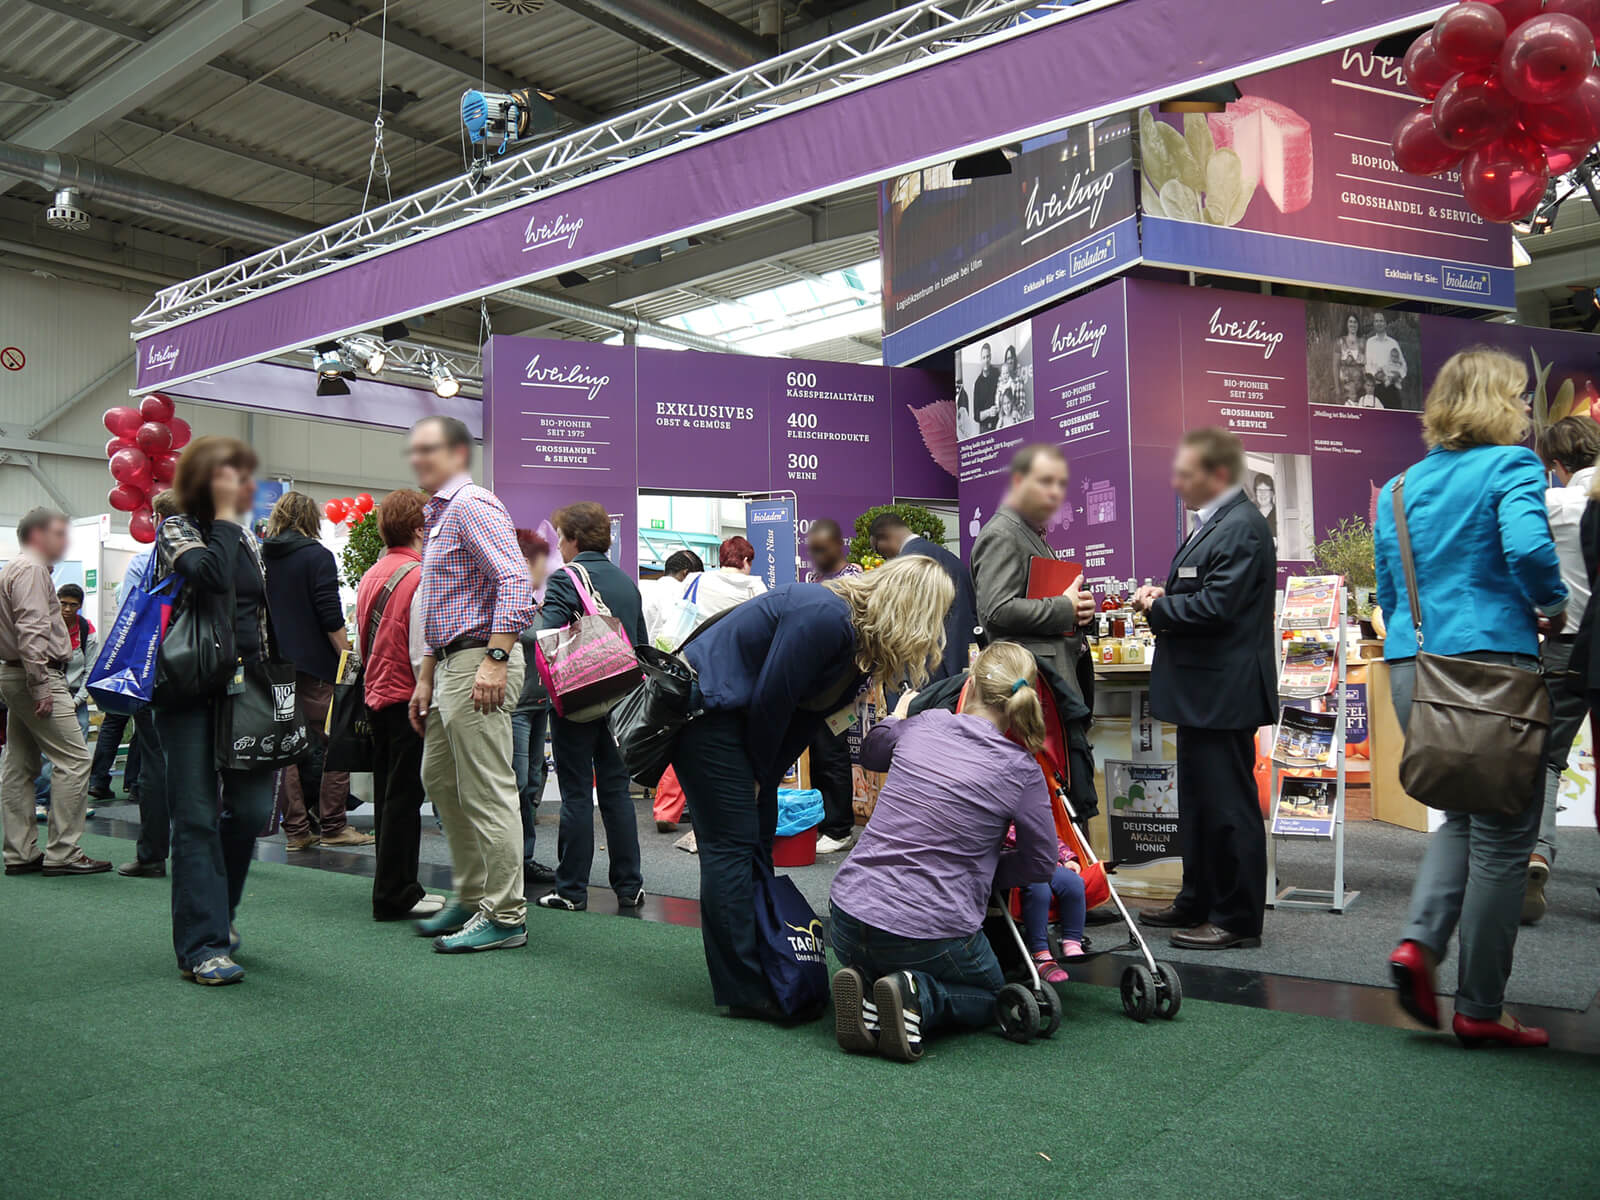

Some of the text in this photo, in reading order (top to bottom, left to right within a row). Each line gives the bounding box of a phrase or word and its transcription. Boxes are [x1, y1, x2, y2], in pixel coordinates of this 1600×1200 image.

[1351, 153, 1404, 173] BIOPION
[1446, 171, 1462, 183] 19
[1341, 191, 1484, 225] GROSSHANDEL & SERVICE
[1023, 277, 1045, 295] Exklusiv
[1073, 246, 1108, 273] bioladen
[896, 285, 934, 311] Logistikzentrum
[934, 281, 941, 291] in
[960, 263, 970, 277] bei
[971, 259, 983, 272] Ulm
[1384, 268, 1412, 280] Exklusiv
[1414, 271, 1424, 281] für
[1446, 272, 1483, 291] bioladen
[787, 371, 817, 388] 600
[1223, 379, 1269, 390] BIO-PIONIER
[786, 389, 875, 402] KÄSESPEZIALITÄTEN
[1061, 382, 1096, 399] BIO-PIONIER
[1230, 390, 1264, 400] SEIT 1975
[1066, 397, 1078, 408] SEIT
[656, 402, 754, 420] EXKLUSIVES
[1220, 408, 1275, 419] GROSSHANDEL
[540, 418, 592, 429] BIO-PIONIER
[656, 417, 731, 430] OBST & GEMÜSE
[787, 413, 818, 429] 400
[1059, 410, 1100, 428] GROSSHANDEL
[1228, 418, 1268, 429] & SERVICE
[547, 428, 585, 438] SEIT 1975
[1071, 422, 1095, 435] SERVICE
[787, 430, 871, 443] FLEISCHPRODUKTE
[535, 445, 597, 455] GROSSHANDEL
[544, 455, 588, 464] & SERVICE
[787, 454, 818, 470] 300
[787, 471, 818, 481] WEINE
[753, 511, 783, 522] bioladen
[1055, 548, 1076, 559] LICHE
[1122, 822, 1178, 833] DEUTSCHER
[1131, 832, 1170, 843] AKAZIEN
[1135, 843, 1166, 853] HONIG
